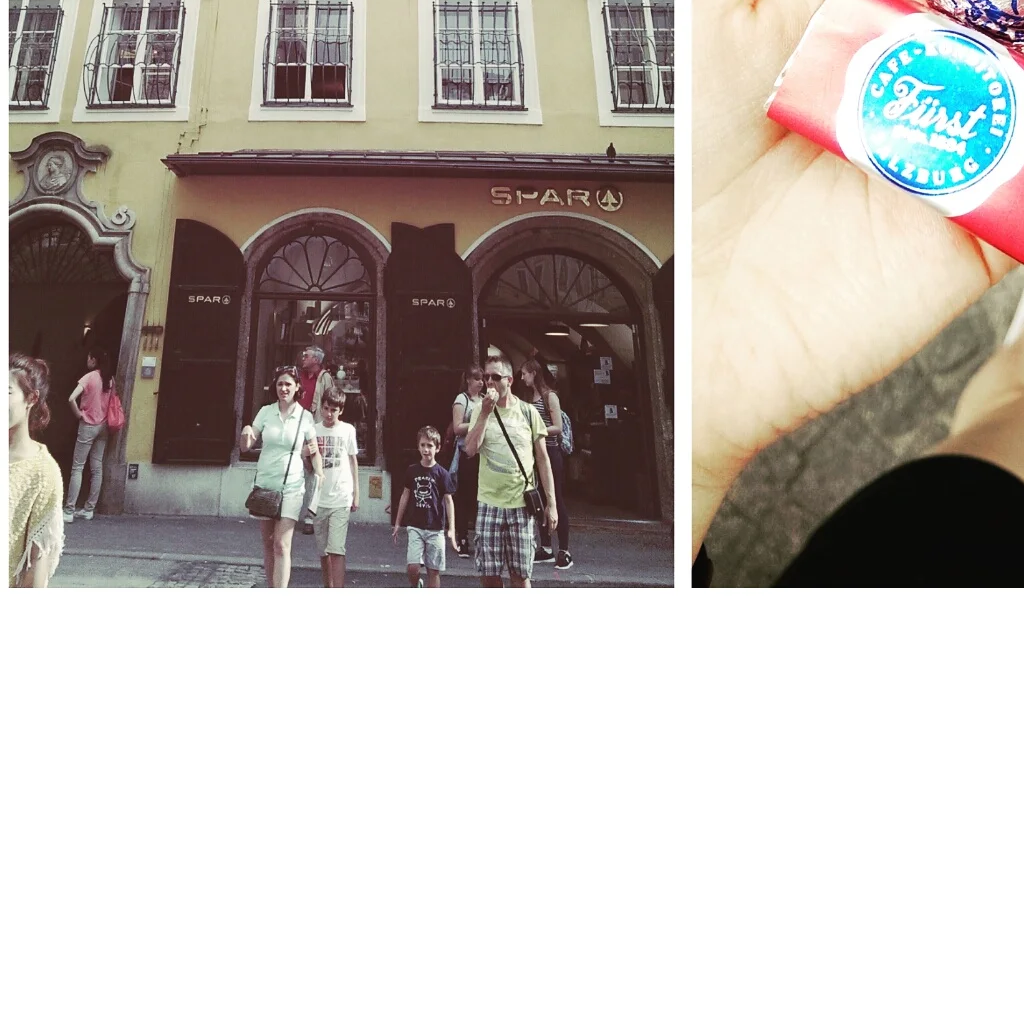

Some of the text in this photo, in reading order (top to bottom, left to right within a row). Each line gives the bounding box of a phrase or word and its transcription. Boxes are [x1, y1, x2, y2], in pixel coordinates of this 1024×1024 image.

[882, 75, 987, 140] Fürst
[490, 186, 592, 207] SPAR
[188, 295, 222, 304] SPAR
[412, 298, 446, 308] SPAR
